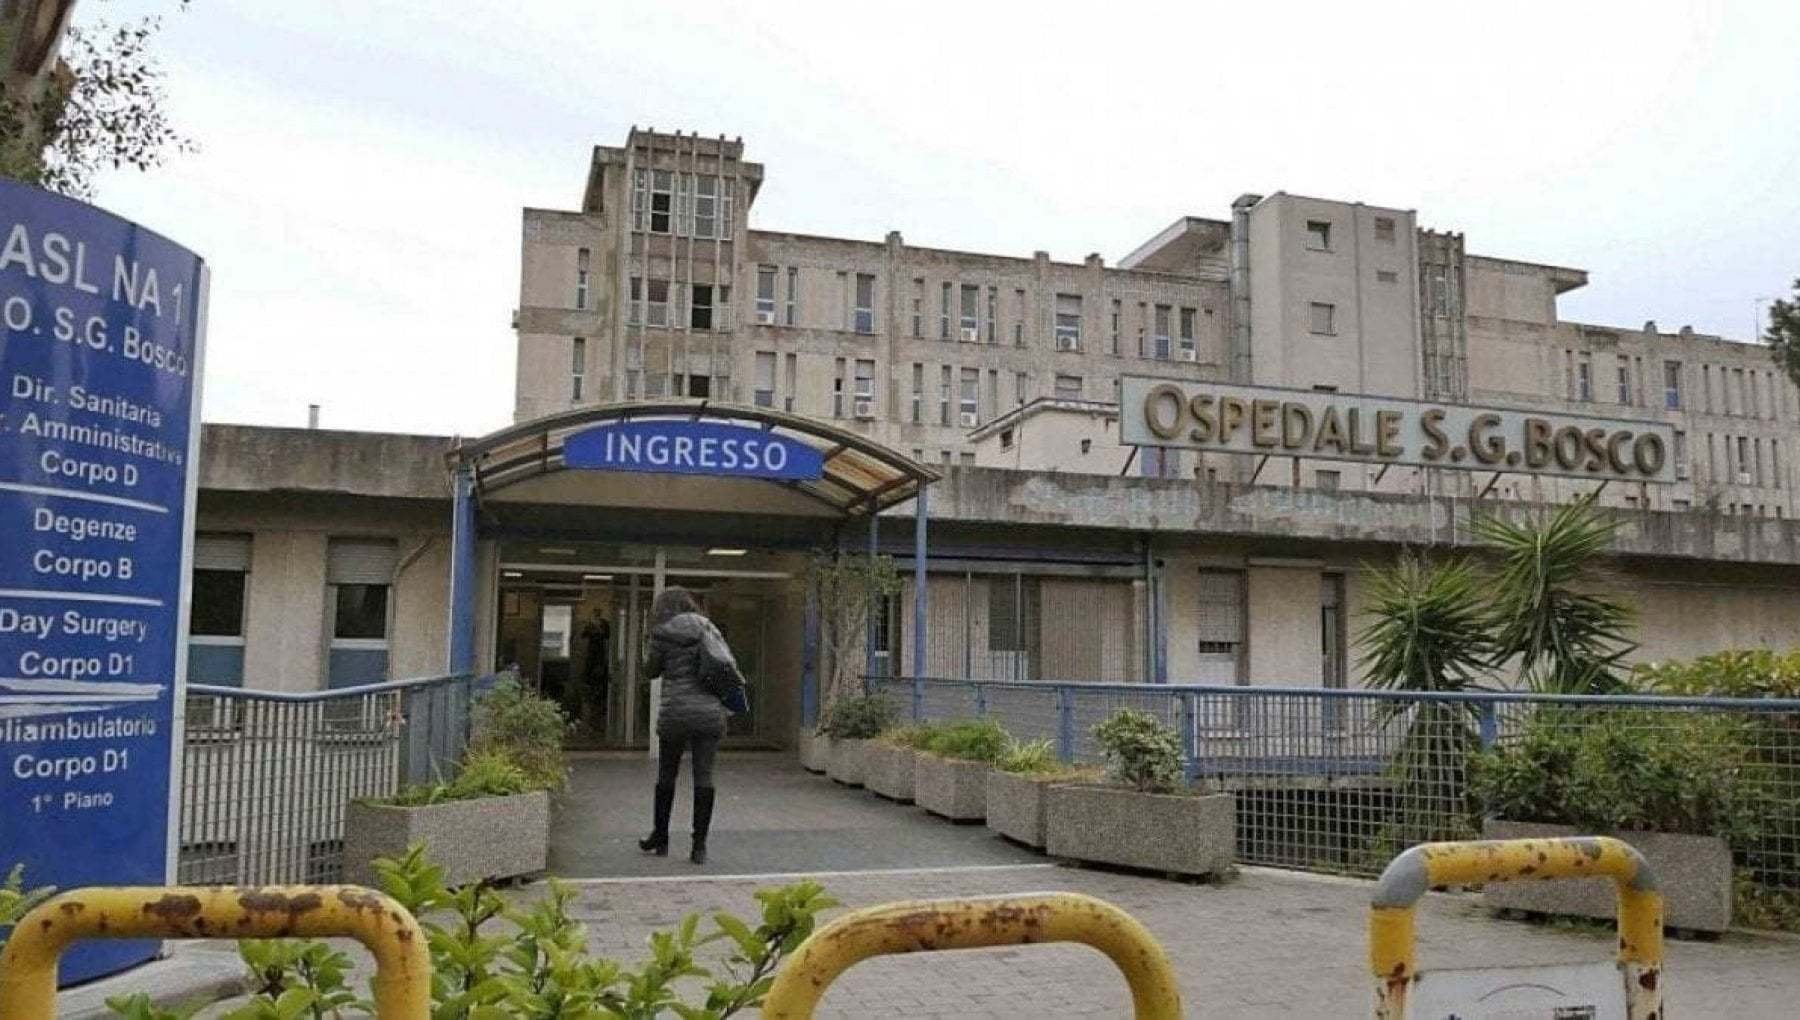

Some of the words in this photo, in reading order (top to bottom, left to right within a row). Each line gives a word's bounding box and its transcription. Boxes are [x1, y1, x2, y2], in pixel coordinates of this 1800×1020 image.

[0, 223, 99, 292] ASL
[112, 253, 161, 316] NA
[172, 283, 184, 325] 1
[54, 307, 114, 352] S.G.
[123, 326, 187, 376] Bosco
[13, 375, 59, 404] Dir.
[69, 386, 161, 427] Sanitaria
[1145, 384, 1401, 456] OSPEDALE
[41, 450, 117, 484] Corpo
[124, 463, 138, 486] D
[605, 432, 787, 471] INGRESSO
[34, 508, 137, 541] Degenze
[33, 549, 111, 581] Corpo
[117, 558, 132, 579] B
[0, 608, 53, 640] Day
[63, 611, 147, 642] Surgery
[20, 651, 101, 680] Corpo
[109, 652, 133, 675] D1
[0, 716, 156, 742] liambulatorio
[14, 754, 96, 782] Corpo
[103, 748, 128, 773] D1
[64, 792, 114, 810] Piano
